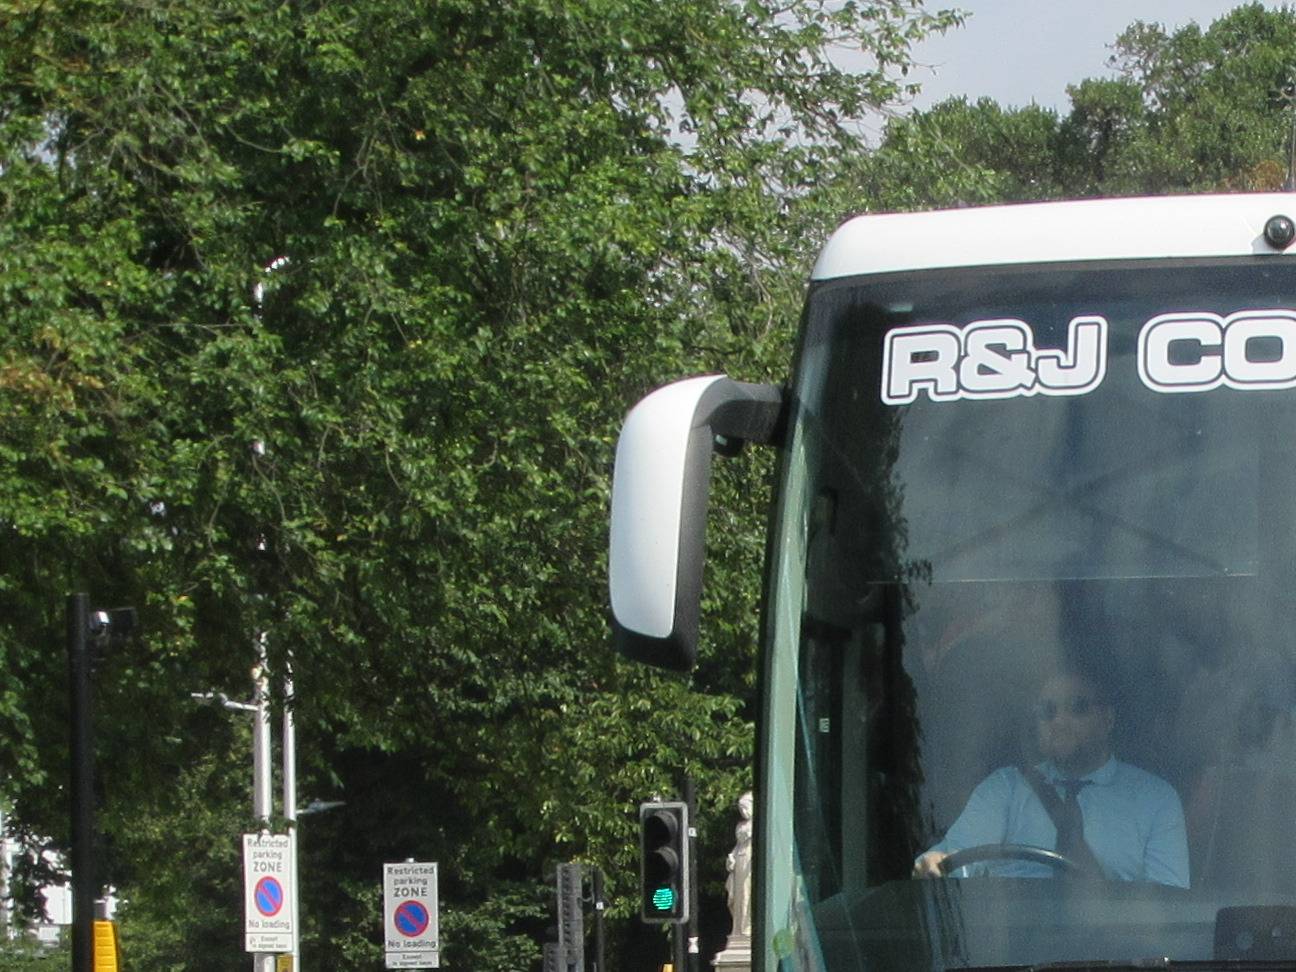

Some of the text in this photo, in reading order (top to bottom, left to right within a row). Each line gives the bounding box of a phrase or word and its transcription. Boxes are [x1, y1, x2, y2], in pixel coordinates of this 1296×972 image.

[881, 315, 1108, 405] R&J
[248, 839, 288, 848] Restricted
[253, 851, 282, 860] parking
[253, 862, 282, 873] ZONE
[387, 867, 434, 875] Restricted
[393, 877, 428, 886] parking
[394, 887, 428, 897] ZONE
[249, 920, 290, 930] No loading
[388, 940, 436, 949] No loading
